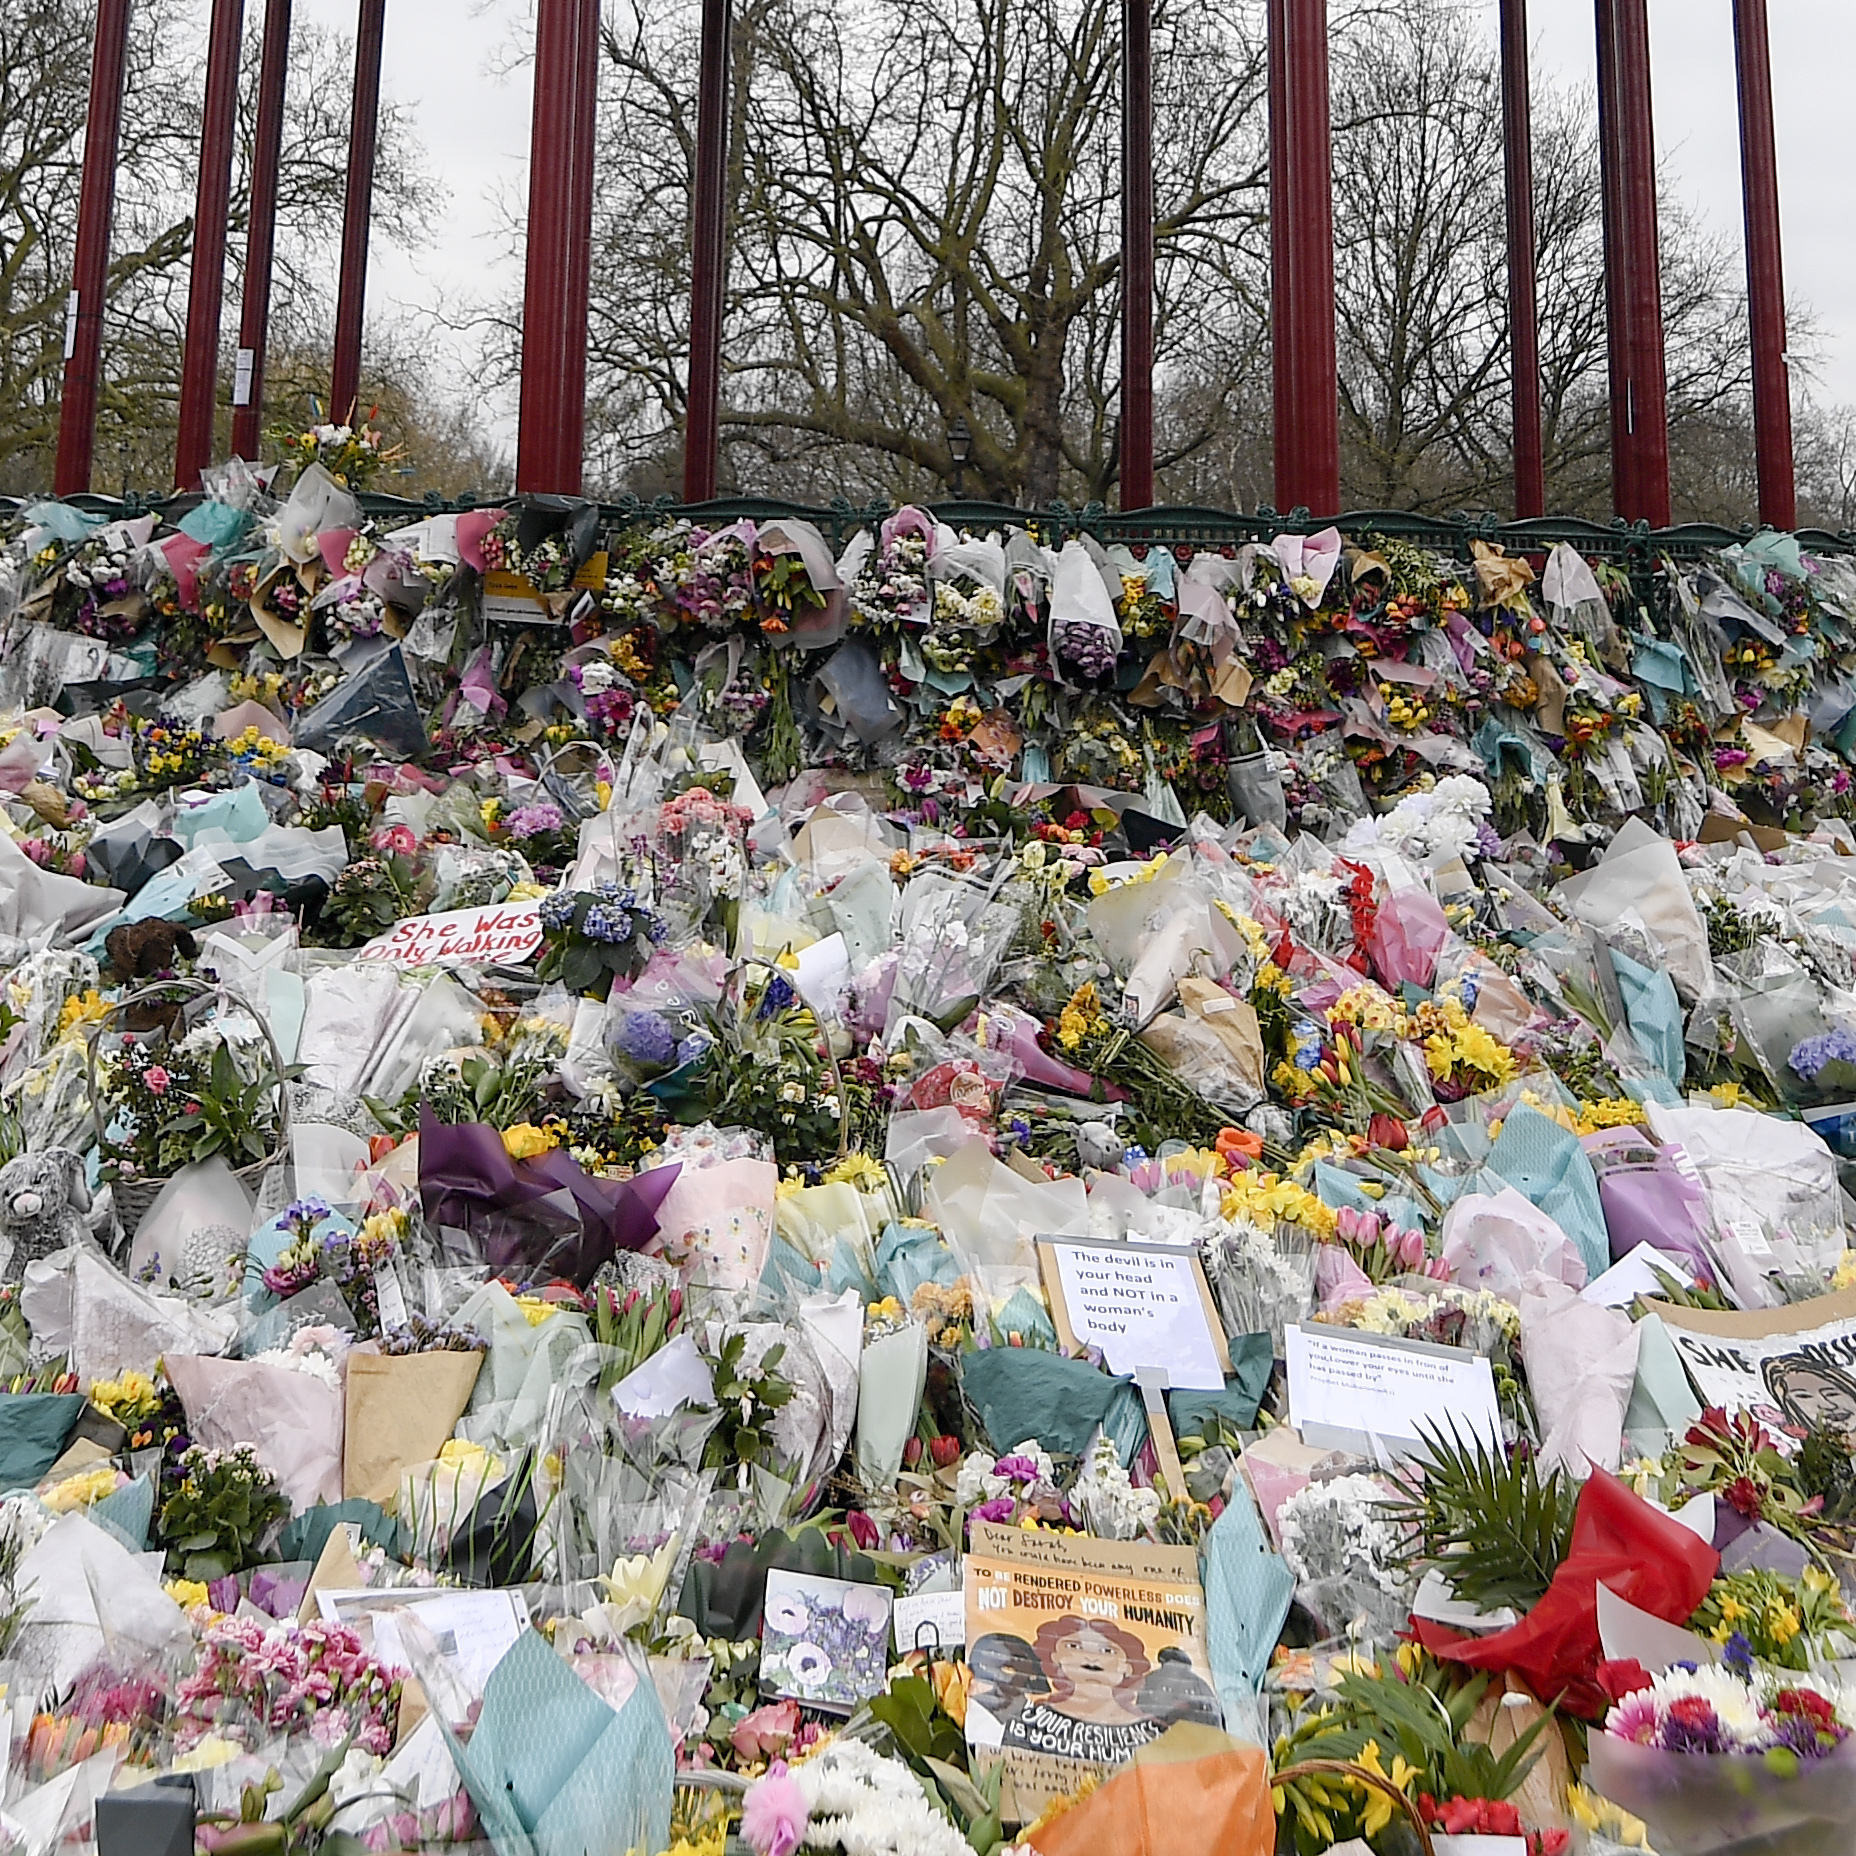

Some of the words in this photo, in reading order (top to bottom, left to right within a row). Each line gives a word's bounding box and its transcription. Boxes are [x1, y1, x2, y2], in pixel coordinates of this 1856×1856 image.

[392, 920, 458, 943] She
[474, 910, 540, 934] Was
[361, 942, 434, 966] Only
[438, 931, 543, 956] Walking
[1072, 1251, 1100, 1263] The
[1104, 1253, 1141, 1267] devil
[1144, 1257, 1156, 1268] is
[1160, 1258, 1175, 1269] in
[1076, 1269, 1111, 1280] your
[1115, 1271, 1153, 1284] head
[1080, 1287, 1108, 1297] and
[1113, 1288, 1146, 1300] NOT
[1151, 1292, 1165, 1302] in
[1169, 1294, 1178, 1303] a
[1083, 1303, 1155, 1318] woman's
[1087, 1319, 1127, 1334] body
[1330, 1345, 1367, 1357] woman
[1370, 1352, 1402, 1363] passes
[1679, 1336, 1755, 1375] SHE
[1309, 1362, 1326, 1372] has
[1329, 1367, 1363, 1379] passed
[1387, 1366, 1410, 1376] eyes
[1412, 1371, 1435, 1380] until
[1437, 1375, 1454, 1384] she
[984, 1527, 1013, 1542] Dear
[993, 1544, 1013, 1554] You
[1020, 1551, 1049, 1562] could
[1053, 1553, 1076, 1565] have
[1081, 1556, 1105, 1569] been
[1111, 1563, 1134, 1576] any
[1144, 1566, 1162, 1574] one
[973, 1567, 992, 1578] TO
[994, 1572, 1010, 1582] BE
[1013, 1572, 1081, 1593] RENDERED
[1084, 1581, 1162, 1603] POWERLESS
[1166, 1593, 1200, 1606] DOES
[978, 1587, 1008, 1610] NOT
[1013, 1588, 1073, 1610] DESTROY
[1080, 1597, 1119, 1618] YOUR
[1123, 1604, 1195, 1637] HUMANITY
[1009, 1719, 1026, 1737] IS
[1029, 1730, 1085, 1759] YOUR
